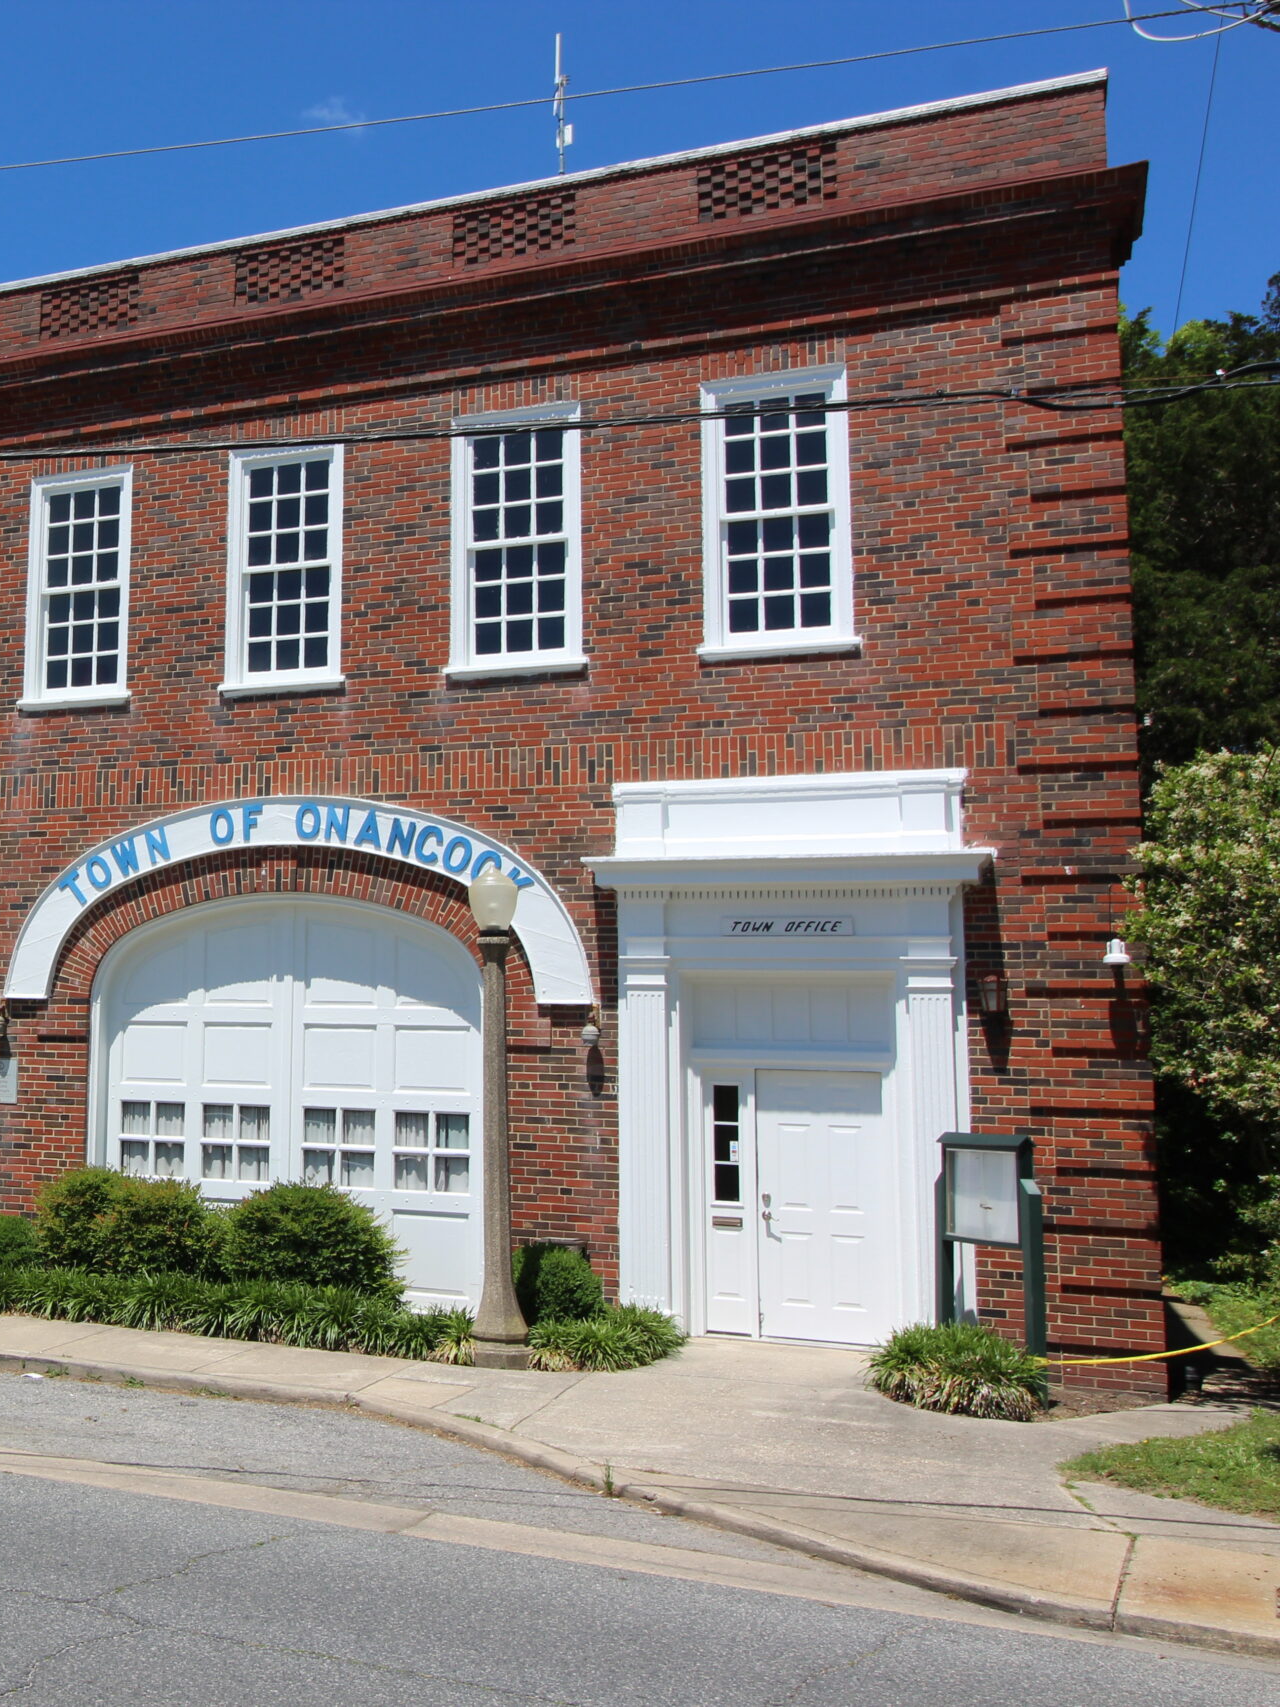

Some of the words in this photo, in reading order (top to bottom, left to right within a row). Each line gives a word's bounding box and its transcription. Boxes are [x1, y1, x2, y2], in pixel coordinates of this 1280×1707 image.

[58, 826, 170, 905] TOWN
[210, 803, 263, 845] OF
[731, 921, 774, 932] TOWN
[784, 921, 842, 932] OFFICE
